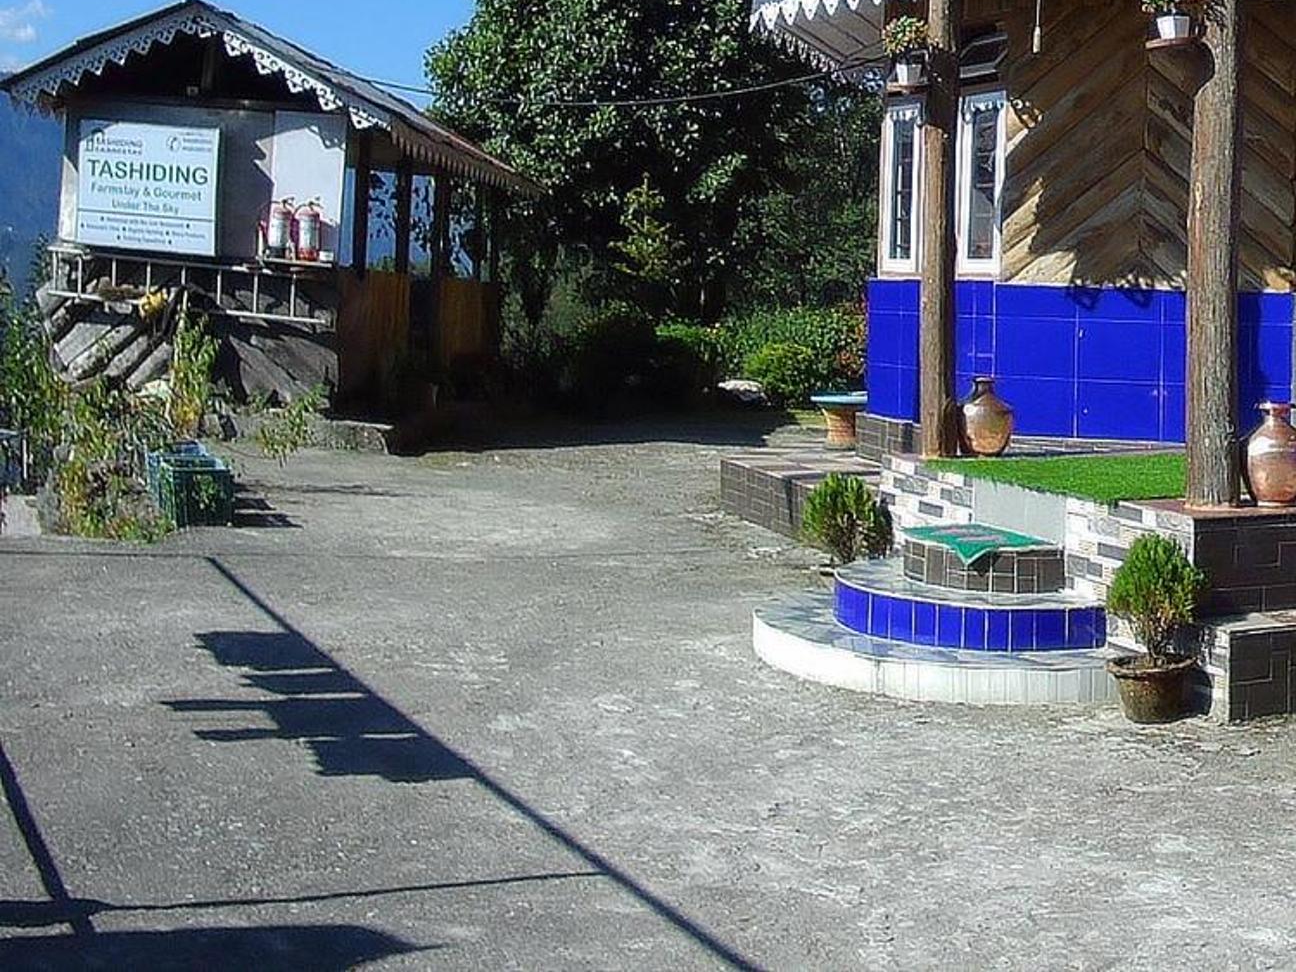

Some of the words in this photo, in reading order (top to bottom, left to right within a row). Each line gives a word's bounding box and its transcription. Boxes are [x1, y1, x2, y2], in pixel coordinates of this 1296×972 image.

[87, 159, 209, 186] TASHIDING
[91, 182, 139, 198] Farmstay
[142, 186, 151, 198] &
[153, 187, 202, 202] Gourmet
[111, 199, 140, 210] Under
[143, 201, 161, 213] The
[163, 204, 179, 215] Sky
